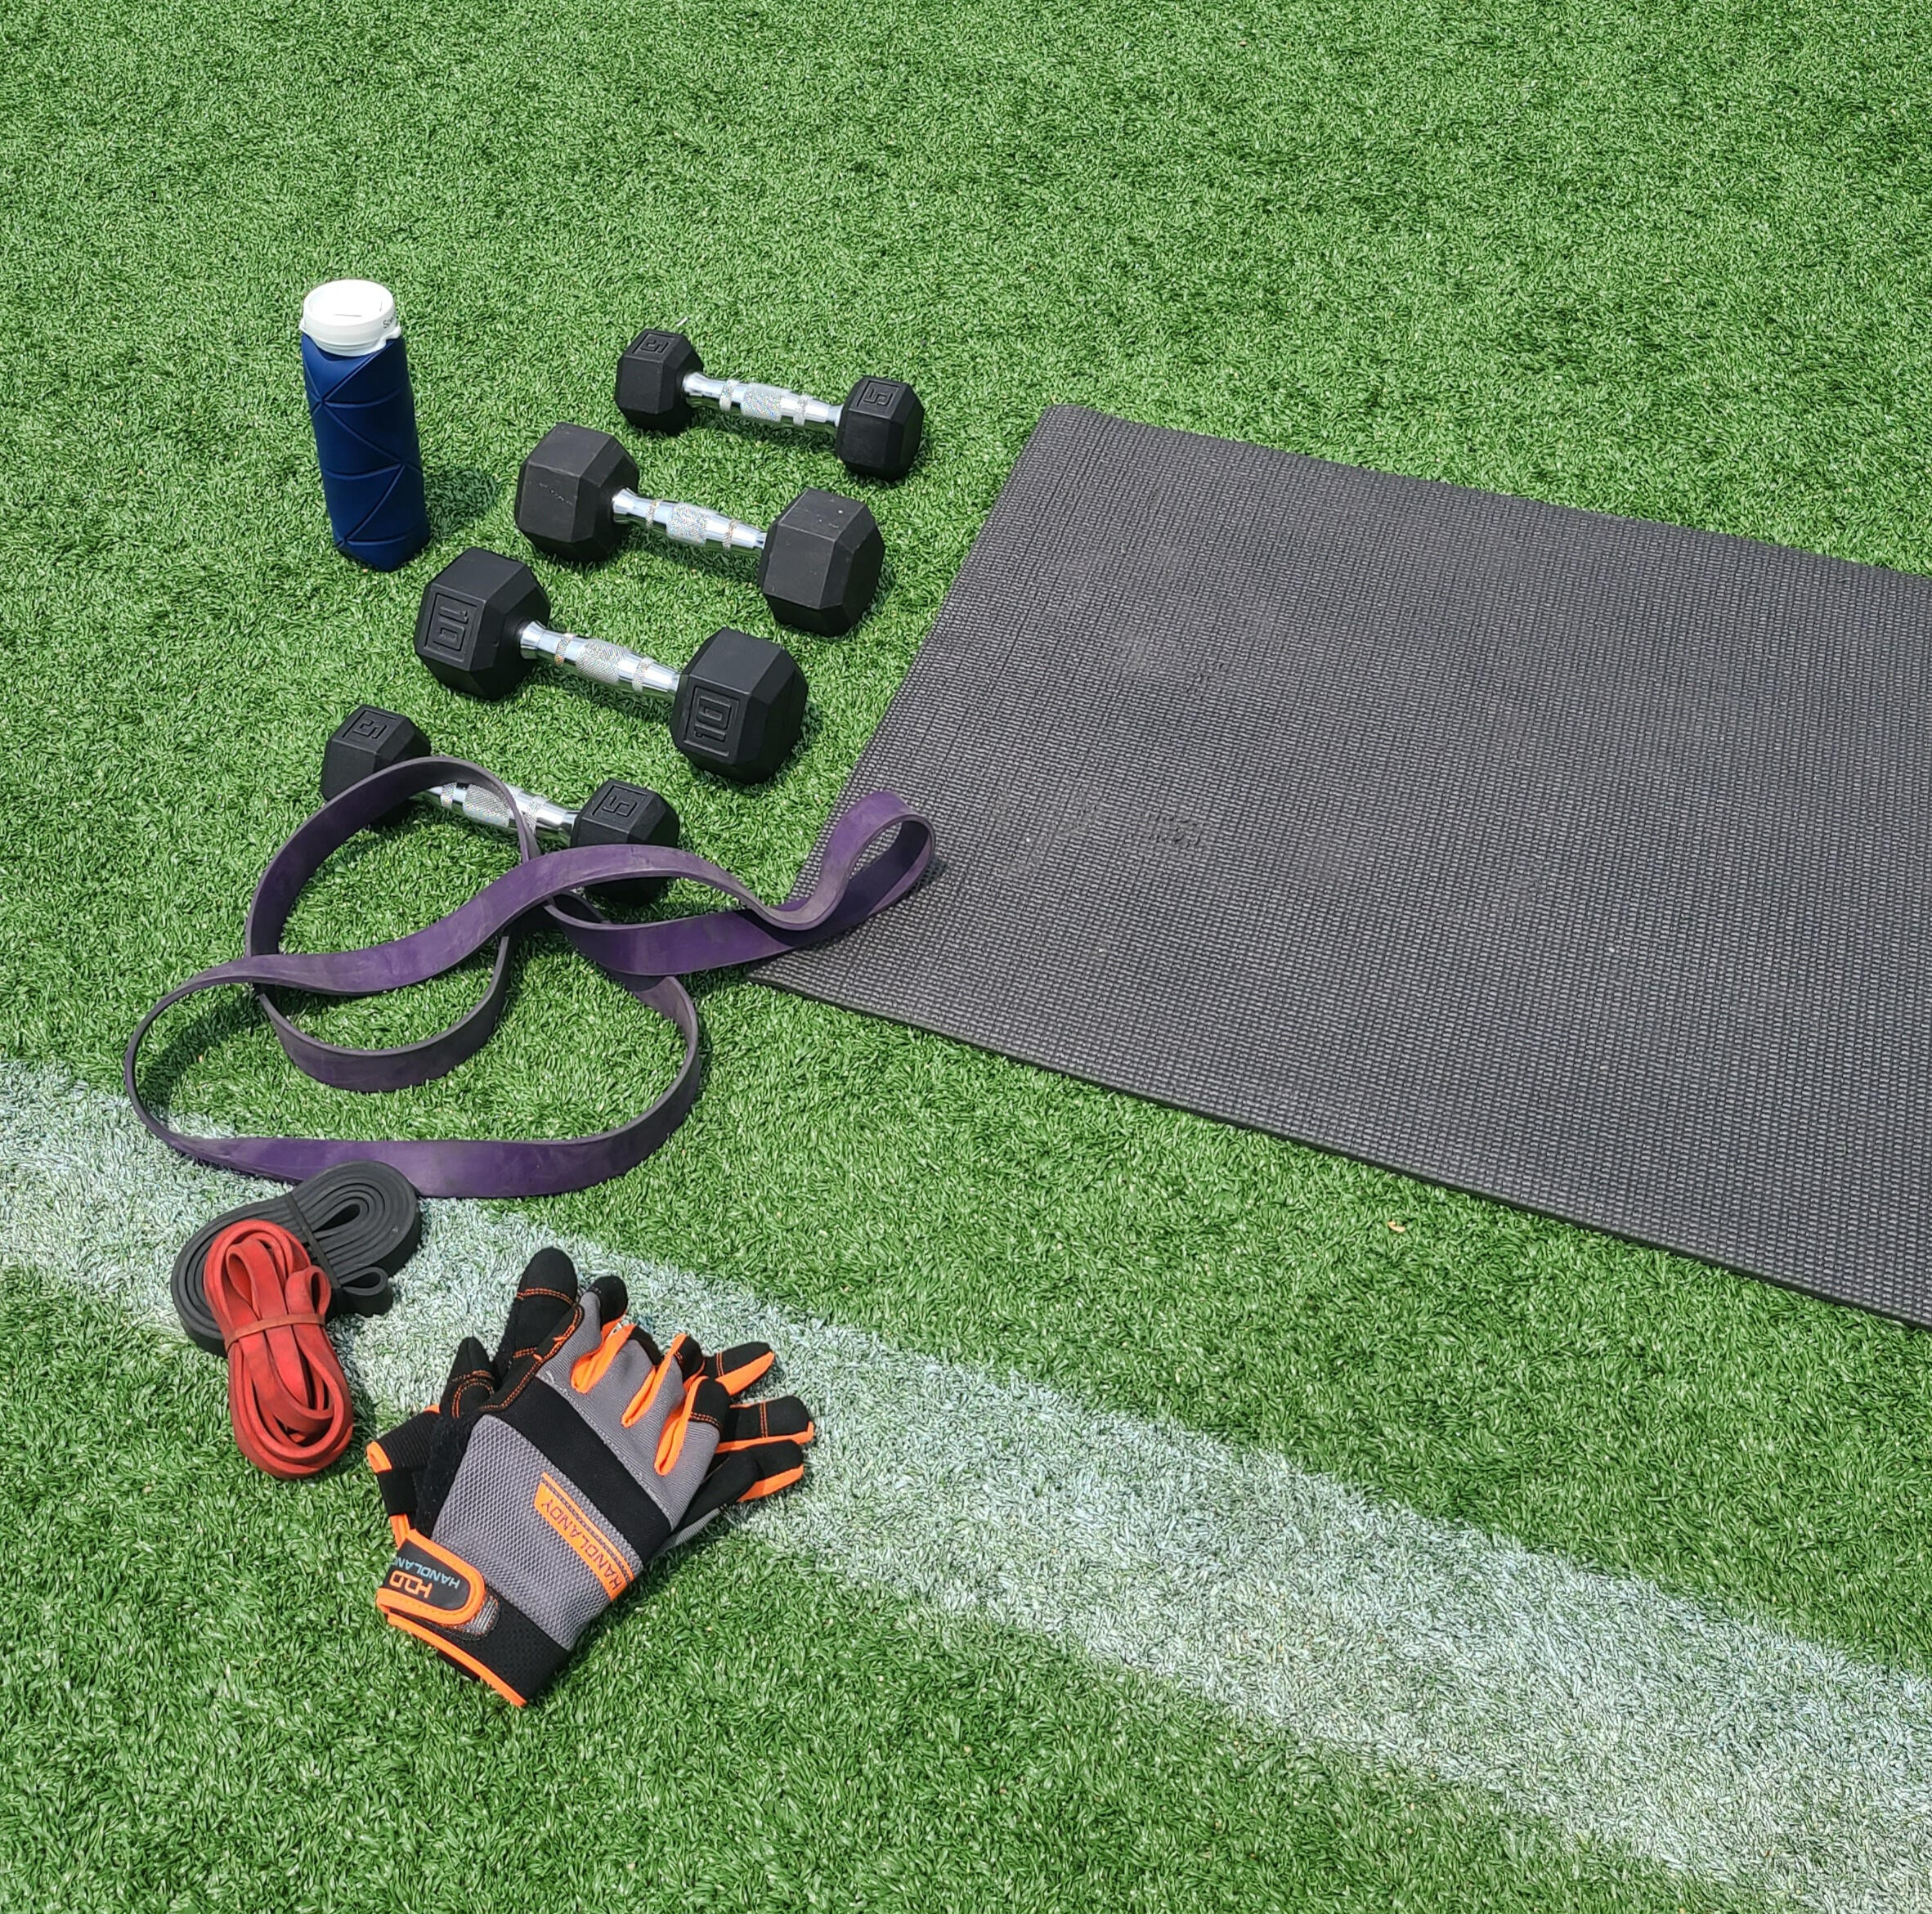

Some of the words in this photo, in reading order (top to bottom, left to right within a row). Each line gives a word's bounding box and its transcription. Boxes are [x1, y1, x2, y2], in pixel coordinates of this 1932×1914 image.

[863, 387, 894, 407] 5
[433, 606, 469, 652] 10
[694, 696, 733, 742] 10
[602, 795, 638, 818] 5
[541, 1499, 623, 1590] HANDLANDY
